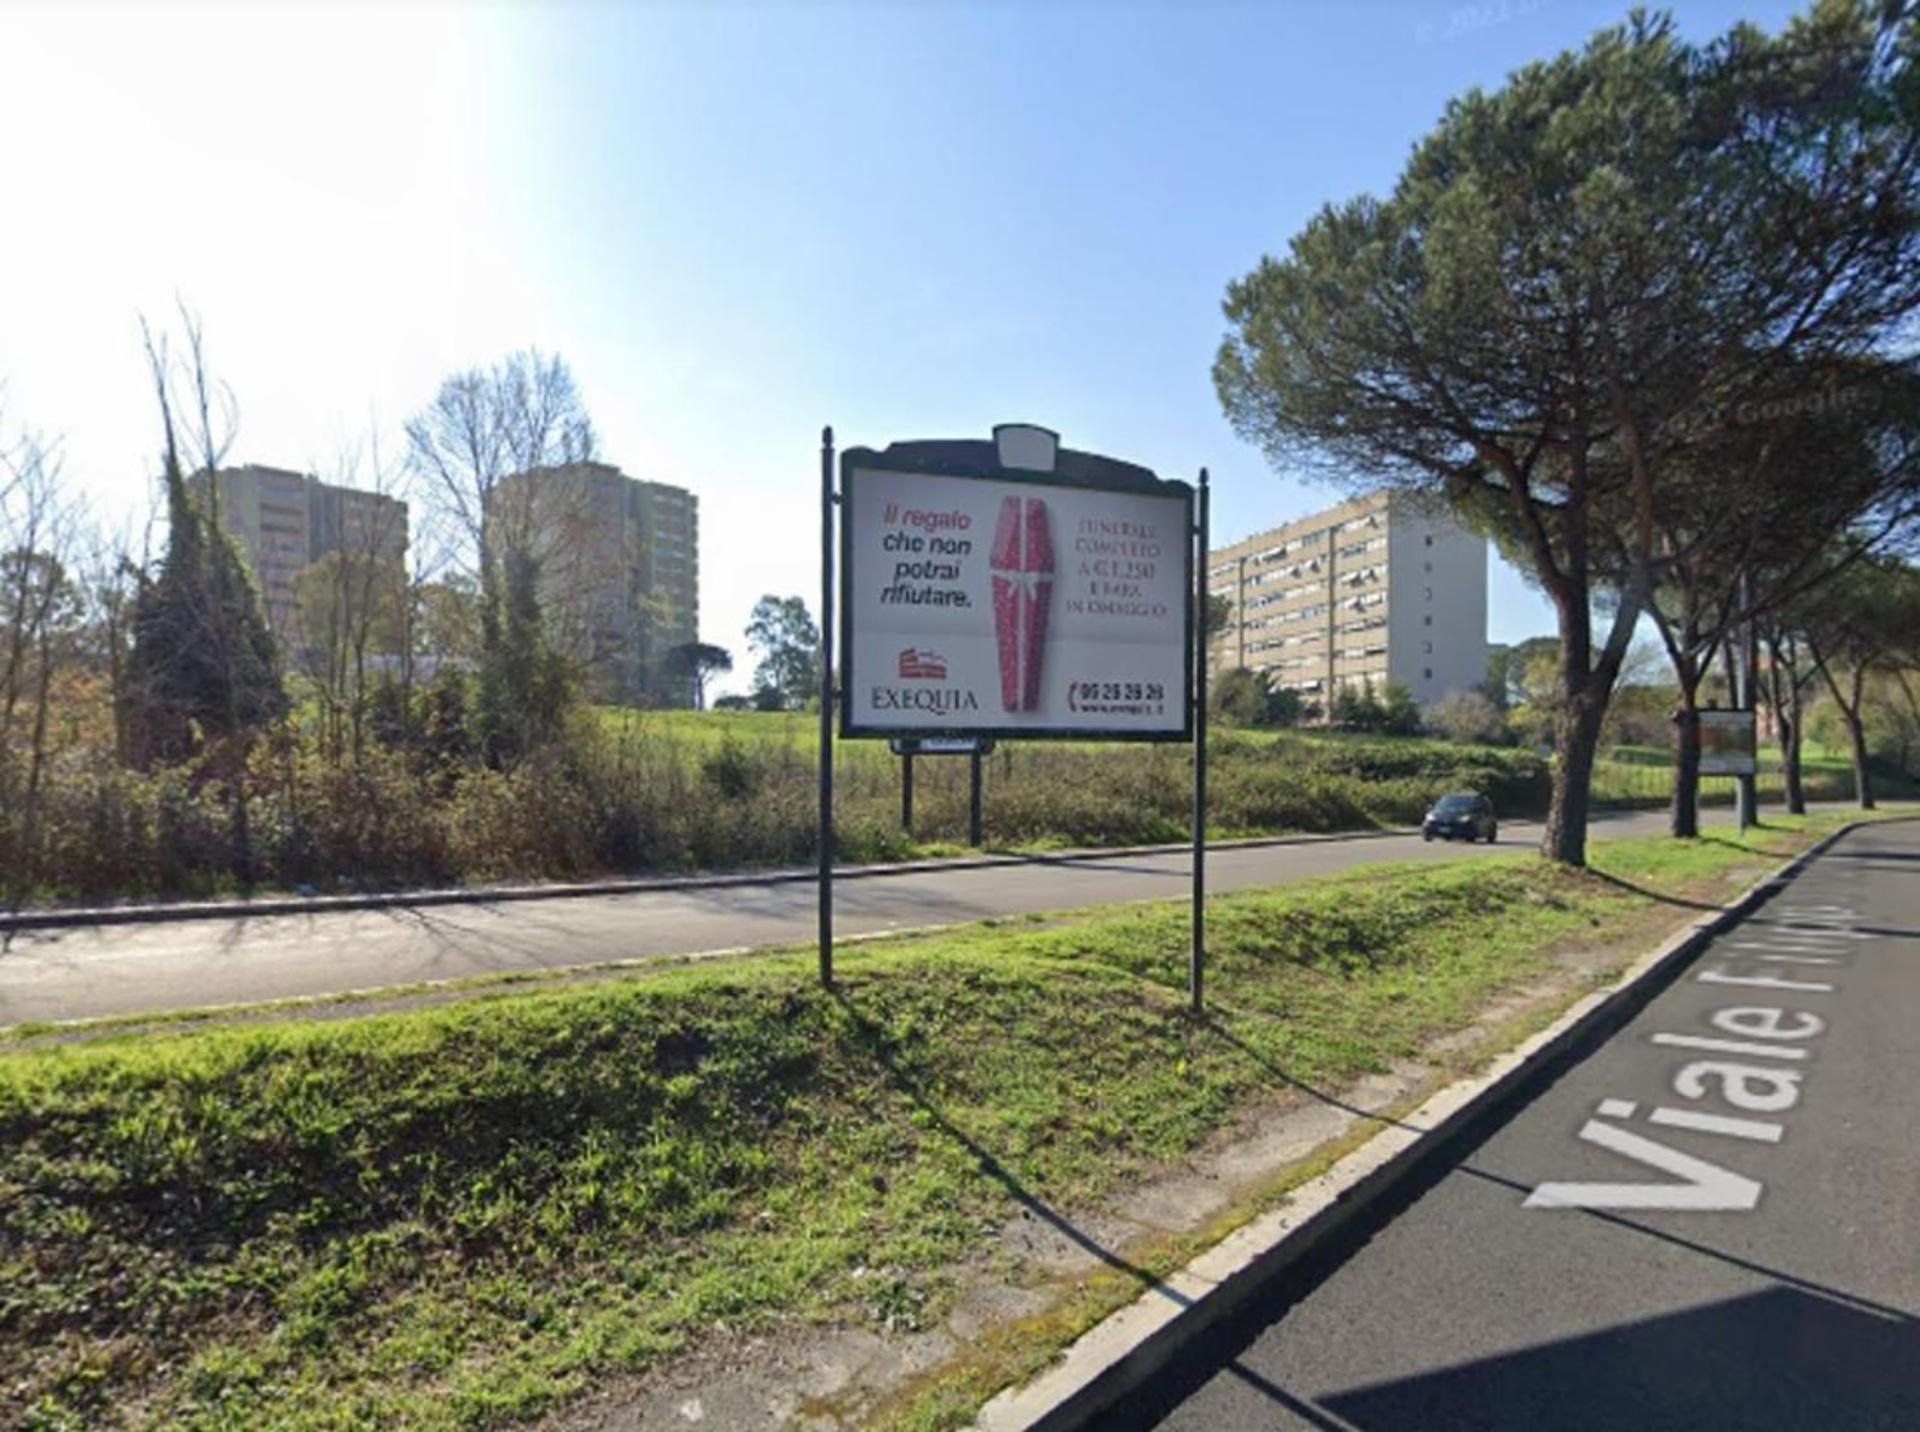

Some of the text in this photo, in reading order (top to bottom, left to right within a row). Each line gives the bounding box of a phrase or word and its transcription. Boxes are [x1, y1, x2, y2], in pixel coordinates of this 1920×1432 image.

[902, 509, 972, 533] regalo
[883, 531, 972, 556] che non
[892, 560, 961, 584] potrai
[880, 584, 972, 608] rifiutare.
[871, 687, 979, 716] EXEQUIA
